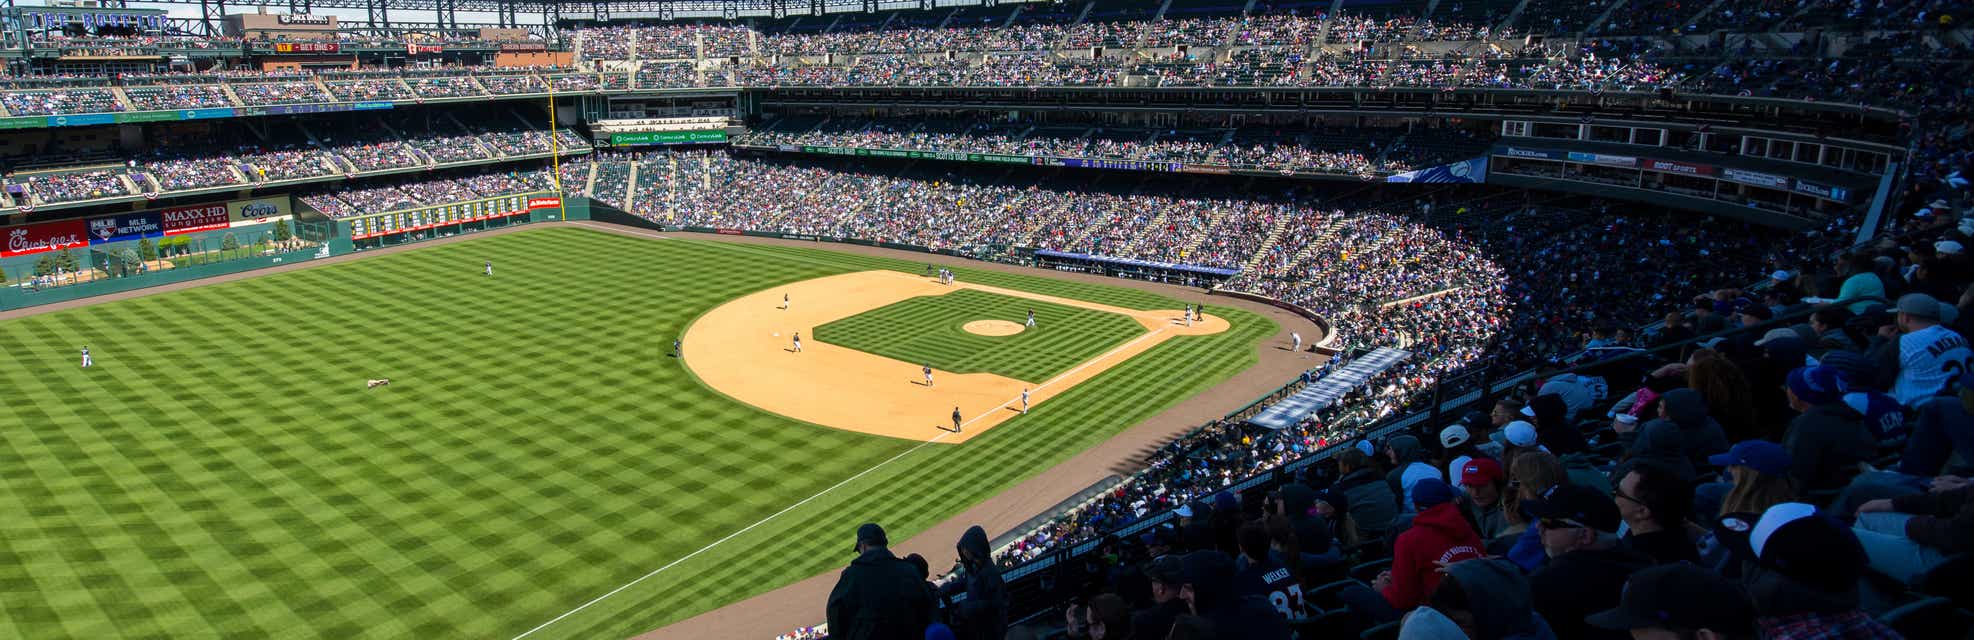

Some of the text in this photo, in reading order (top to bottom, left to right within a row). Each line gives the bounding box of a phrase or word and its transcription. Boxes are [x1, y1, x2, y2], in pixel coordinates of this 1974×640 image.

[30, 12, 66, 27] THE
[164, 206, 225, 222] MAXX HD
[242, 204, 277, 217] Coors
[118, 223, 158, 234] NETWORK
[1262, 567, 1290, 584] WELKER
